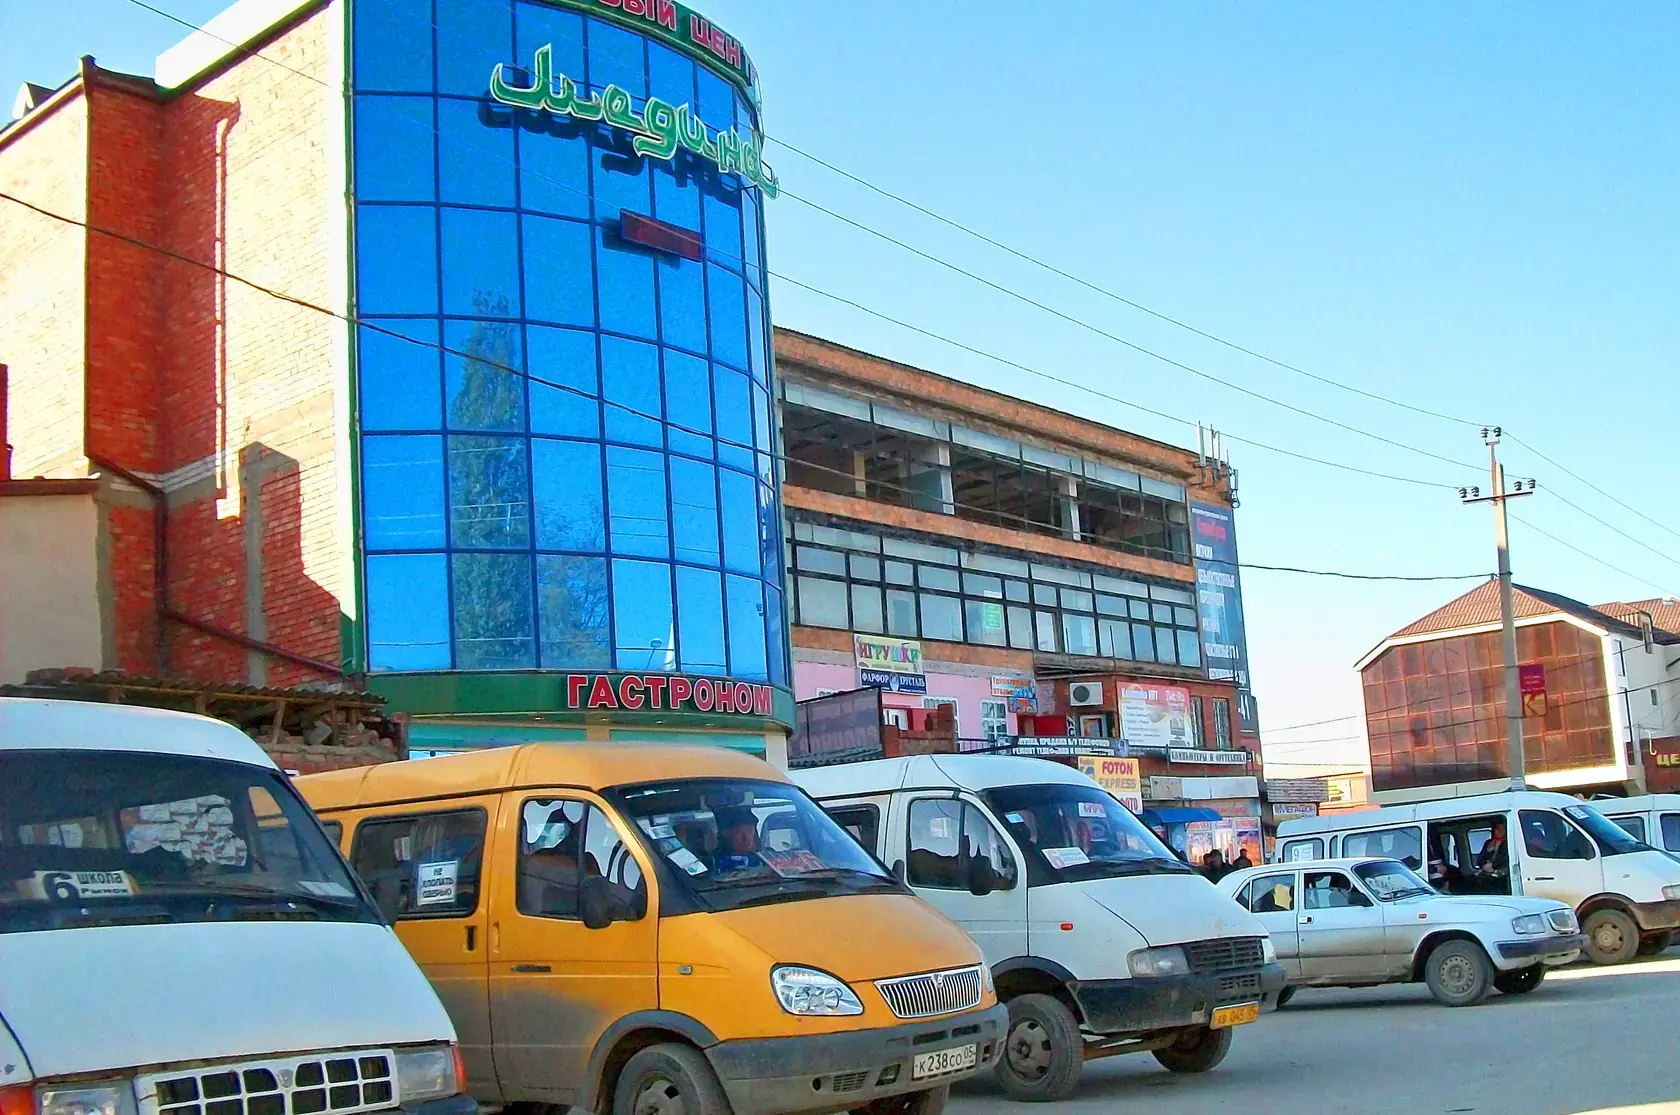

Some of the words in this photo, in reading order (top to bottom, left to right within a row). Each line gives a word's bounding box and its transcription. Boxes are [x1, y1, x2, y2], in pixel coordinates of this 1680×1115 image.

[862, 672, 889, 684] ФАРФОР
[567, 674, 773, 716] ГАСТРОНОМ
[1102, 761, 1133, 775] FOTON
[1099, 778, 1136, 789] EXPRESS
[43, 872, 80, 903] 6
[963, 1045, 974, 1060] 05
